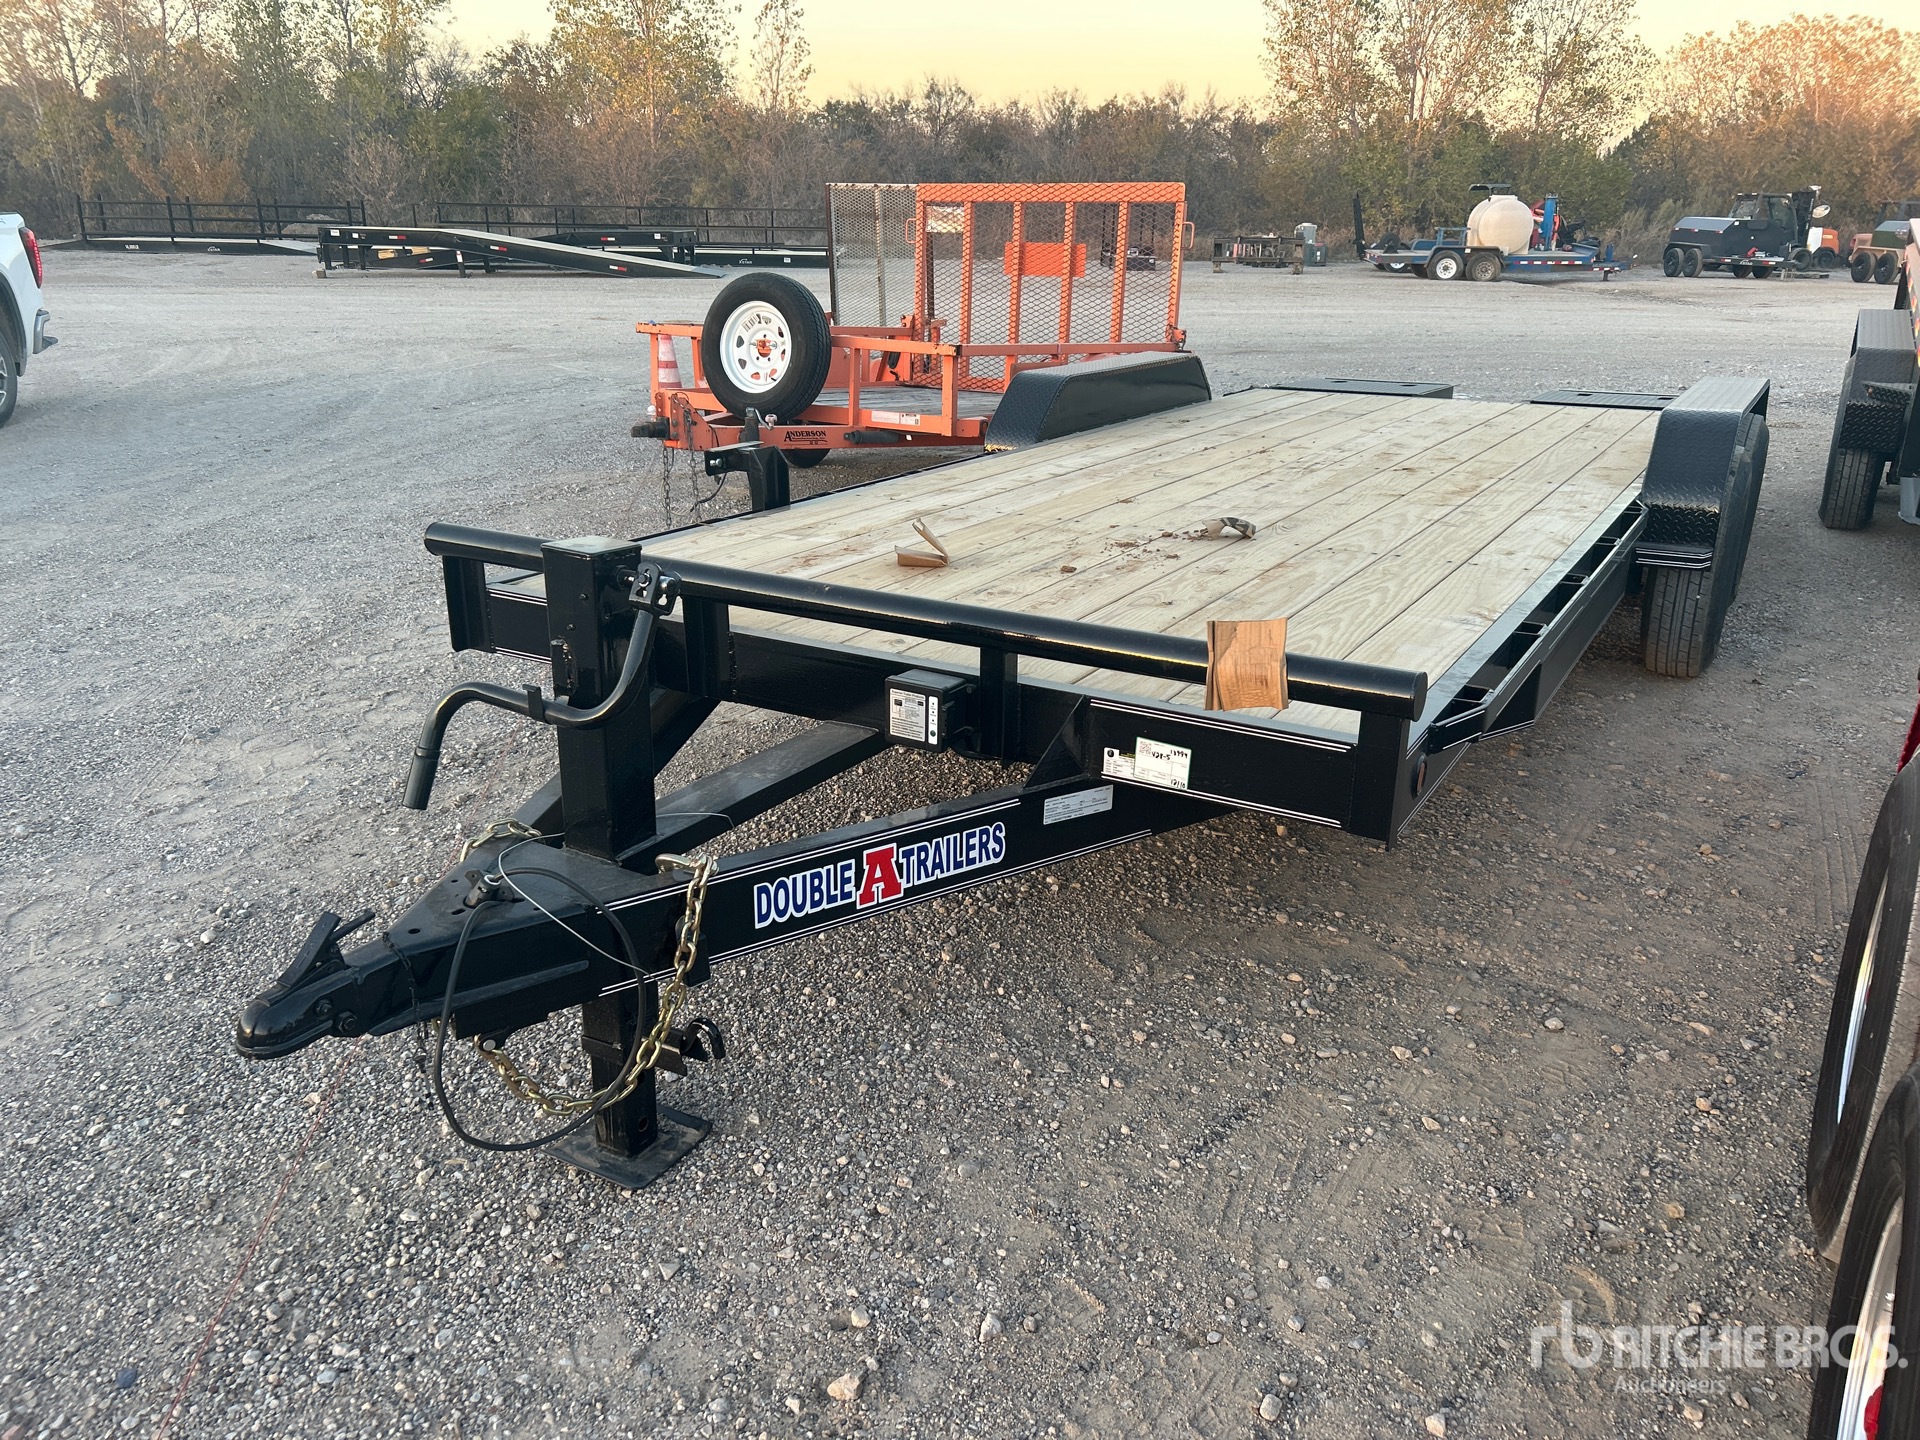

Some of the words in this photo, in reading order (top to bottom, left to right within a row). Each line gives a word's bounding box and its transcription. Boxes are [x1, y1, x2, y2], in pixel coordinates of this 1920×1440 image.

[784, 430, 827, 442] ANDERSON
[754, 859, 856, 929] DOUBLE
[857, 843, 904, 909] A
[899, 822, 1006, 888] TRAILERS
